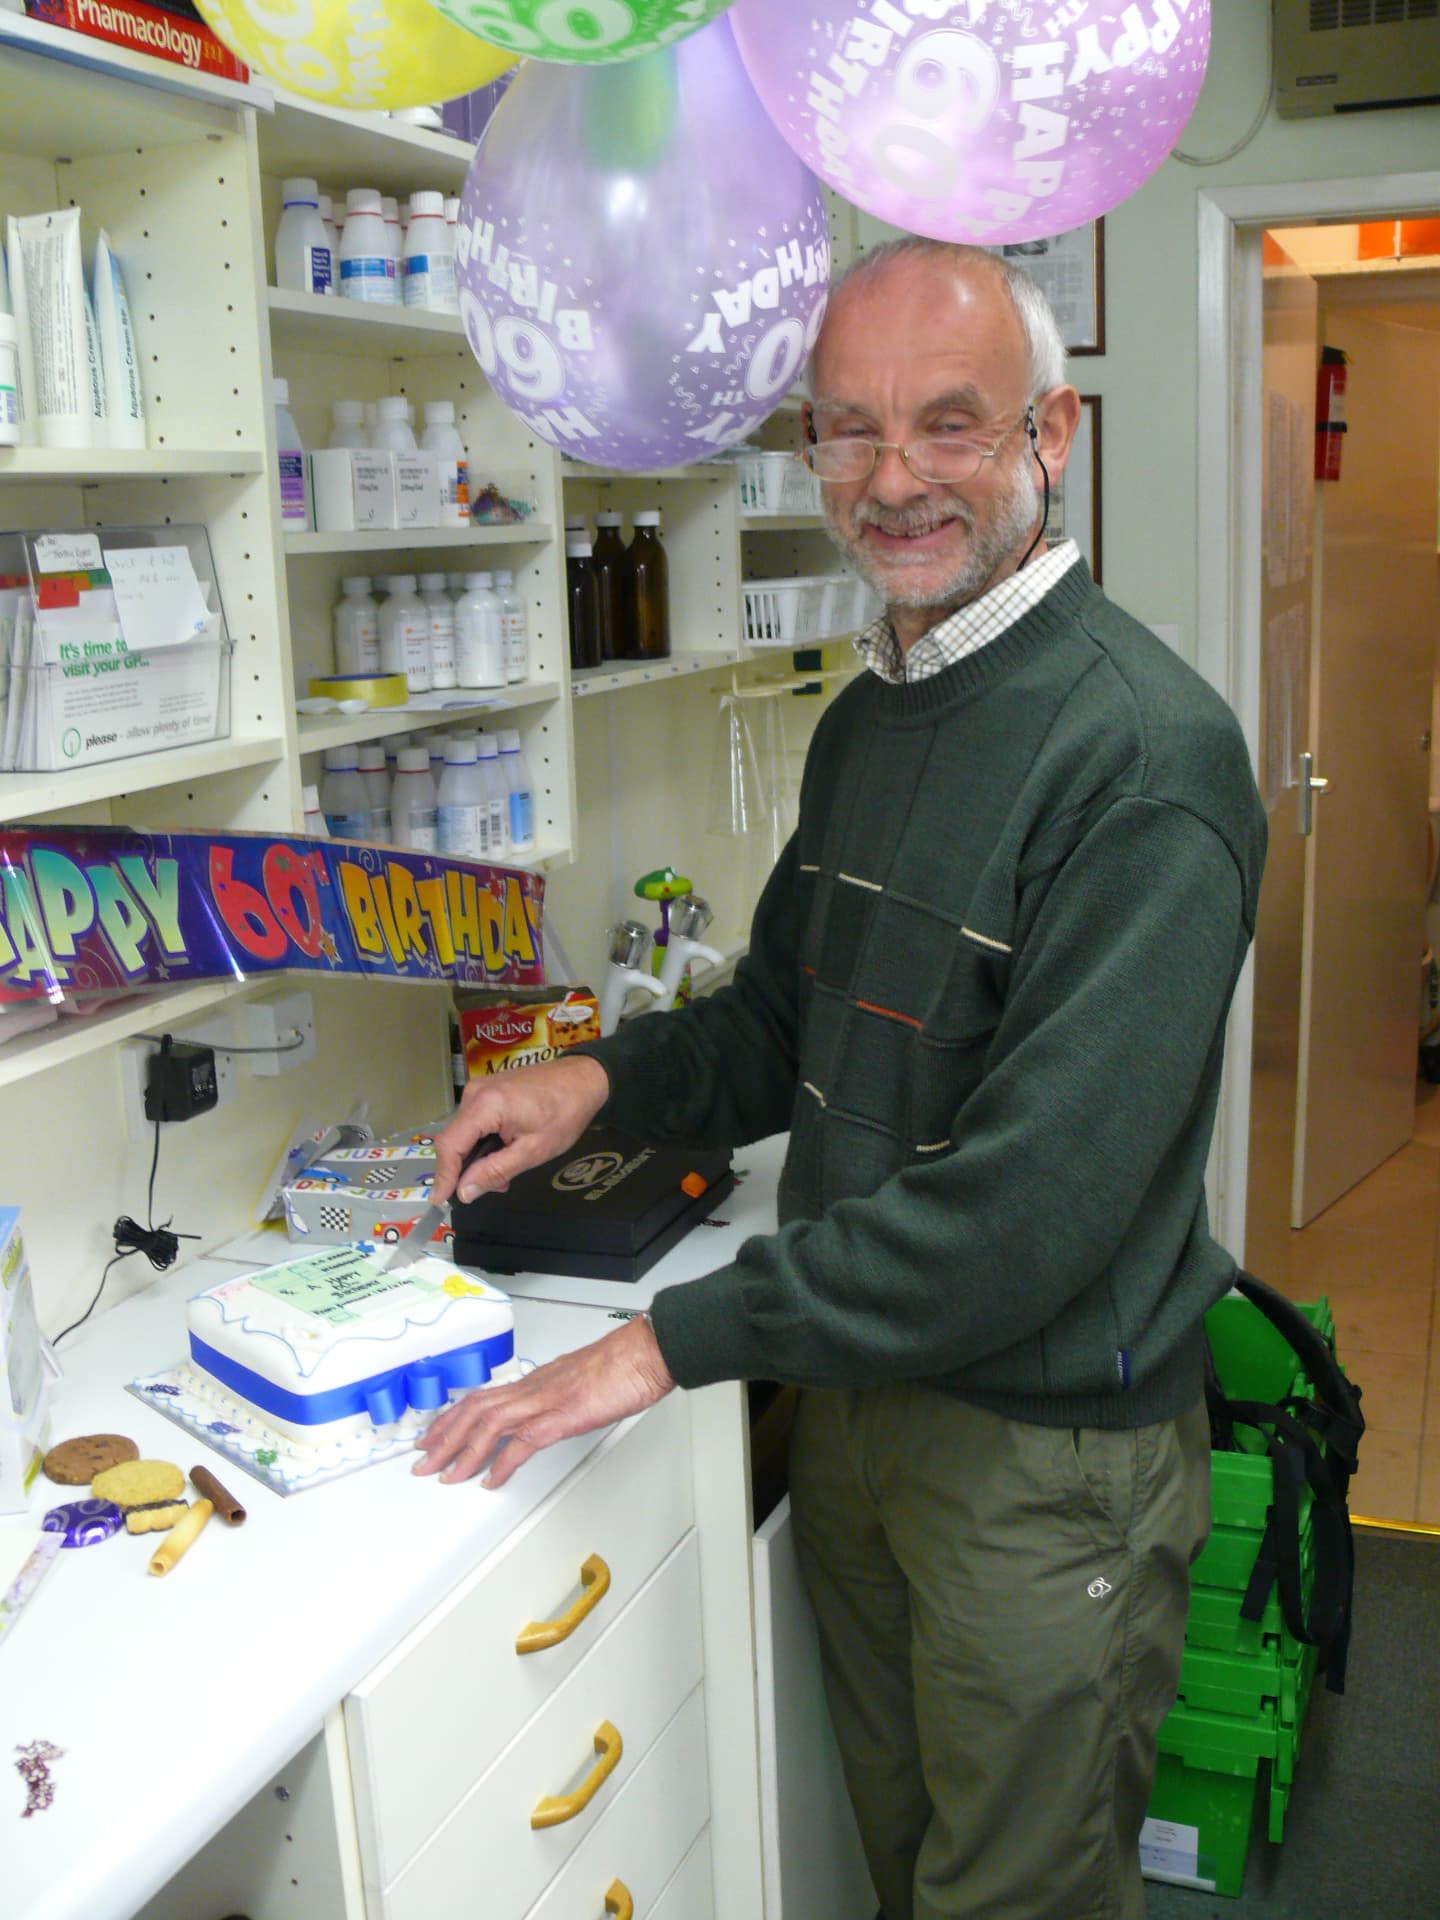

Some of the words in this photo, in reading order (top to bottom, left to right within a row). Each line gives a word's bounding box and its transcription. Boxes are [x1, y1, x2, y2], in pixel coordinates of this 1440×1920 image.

[77, 0, 201, 68] Pharmacology
[876, 27, 1001, 200] 60
[128, 368, 139, 419] Aqueous
[60, 641, 79, 660] It's
[83, 638, 111, 657] time
[62, 662, 90, 678] visit
[94, 658, 119, 677] your
[86, 732, 118, 750] please
[475, 1020, 532, 1040] KIPLING
[336, 1148, 399, 1160] JUST
[404, 1146, 436, 1157] FO
[352, 1188, 414, 1200] JUST
